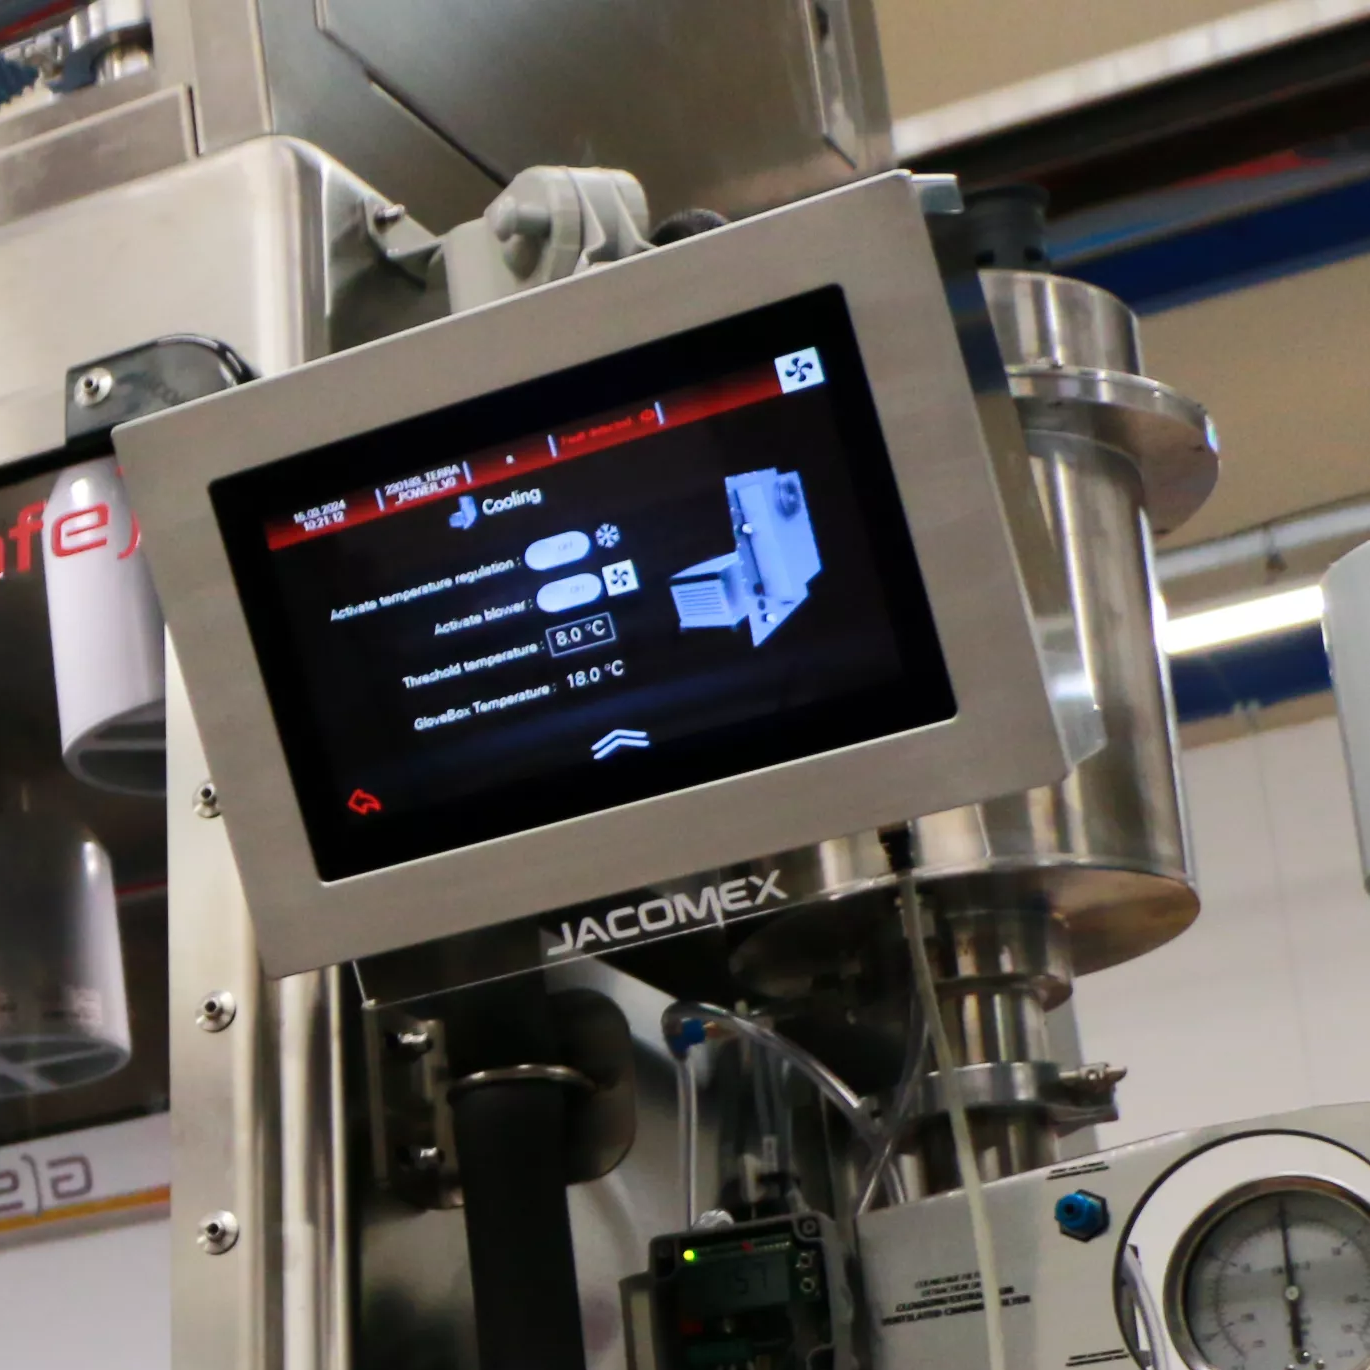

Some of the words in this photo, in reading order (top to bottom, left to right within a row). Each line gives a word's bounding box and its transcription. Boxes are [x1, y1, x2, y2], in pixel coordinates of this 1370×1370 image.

[481, 487, 542, 516] Cooling
[330, 598, 378, 622] Activate
[378, 576, 453, 607] temperature
[455, 558, 515, 584] regulation
[434, 612, 483, 636] Activate
[484, 599, 528, 622] blower
[555, 626, 582, 648] 8.0
[584, 619, 607, 637] °C
[402, 661, 462, 690] Threshold
[462, 641, 539, 672] temperature
[566, 665, 601, 689] 18.0
[603, 659, 625, 677] °C
[413, 703, 472, 732] GloveBox
[472, 683, 551, 716] Temperature
[547, 869, 789, 956] JACOMEX
